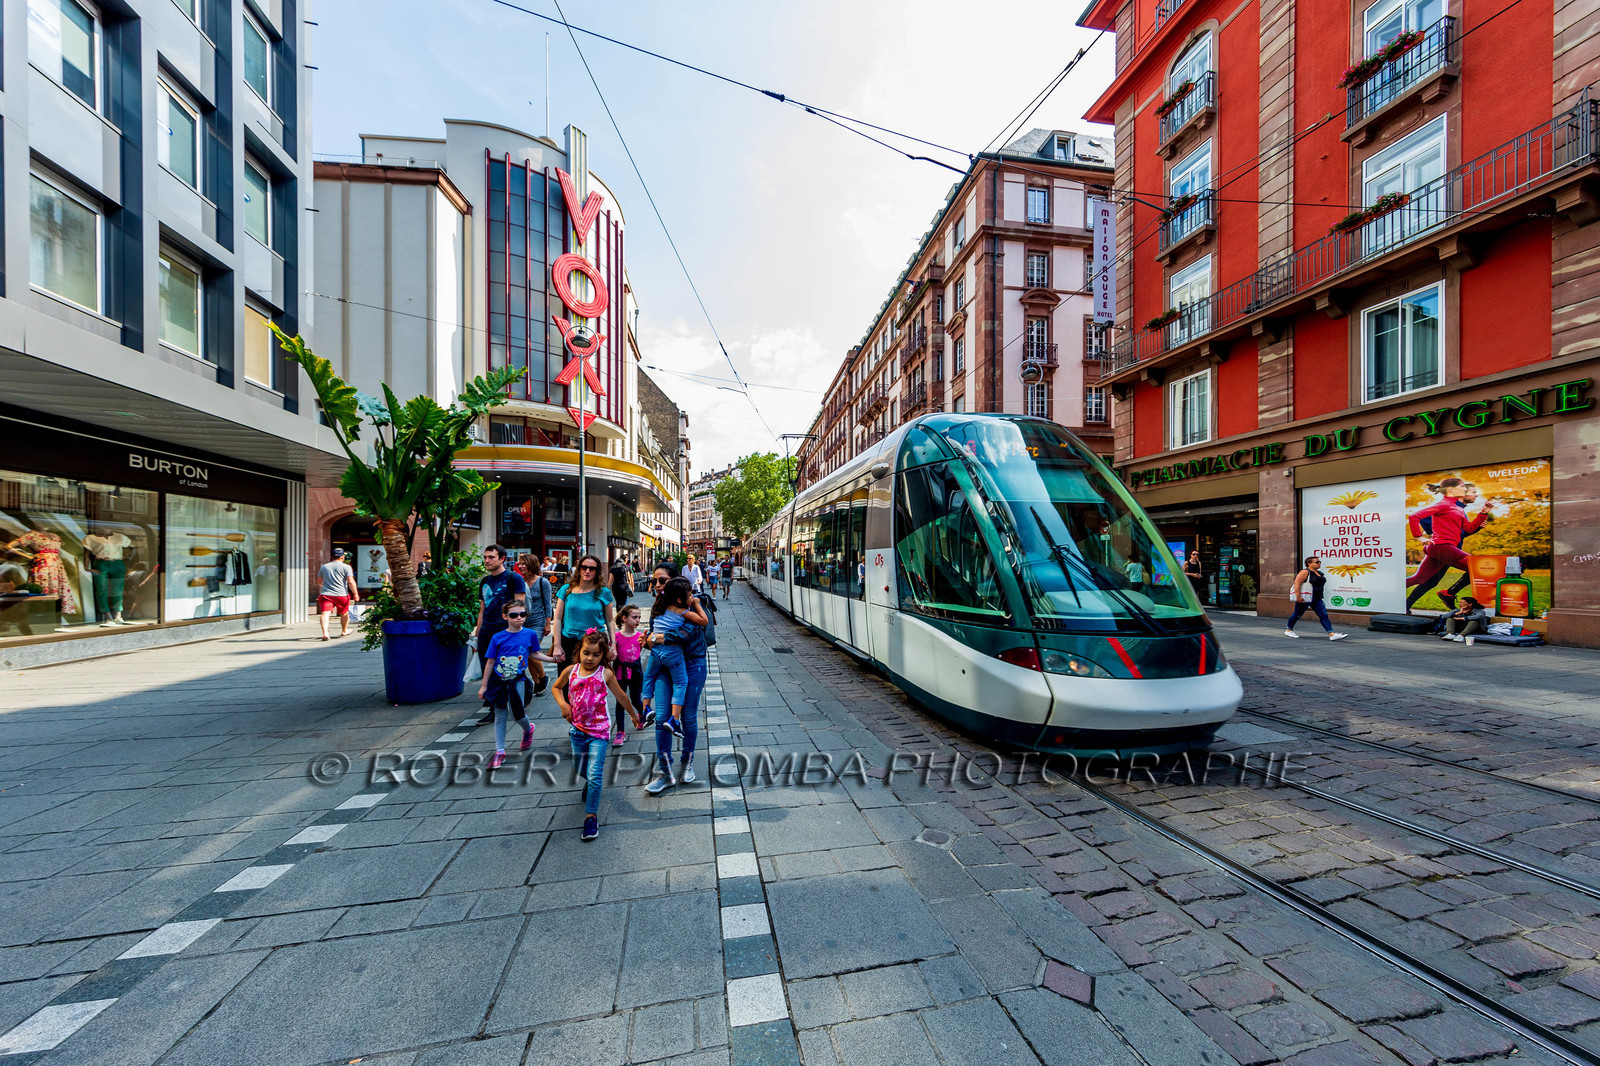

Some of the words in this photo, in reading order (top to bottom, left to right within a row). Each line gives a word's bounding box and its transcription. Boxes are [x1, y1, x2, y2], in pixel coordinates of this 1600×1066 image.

[1101, 208, 1110, 262] MAISON
[552, 166, 609, 397] VOX
[1101, 265, 1109, 309] ROUGE
[1096, 310, 1113, 319] HOTEL
[1130, 441, 1286, 488] PHARMACIE
[1302, 425, 1361, 458] DU
[1382, 376, 1594, 442] CYGNE
[129, 453, 208, 481] BURTON
[1487, 465, 1538, 478] WELEDA
[187, 480, 208, 489] London
[1323, 512, 1381, 526] L'ARNICA
[1338, 525, 1364, 536] BIO,
[1323, 537, 1349, 547] L'OR
[1354, 536, 1381, 546] DES
[1313, 547, 1393, 558] CHAMPIONS
